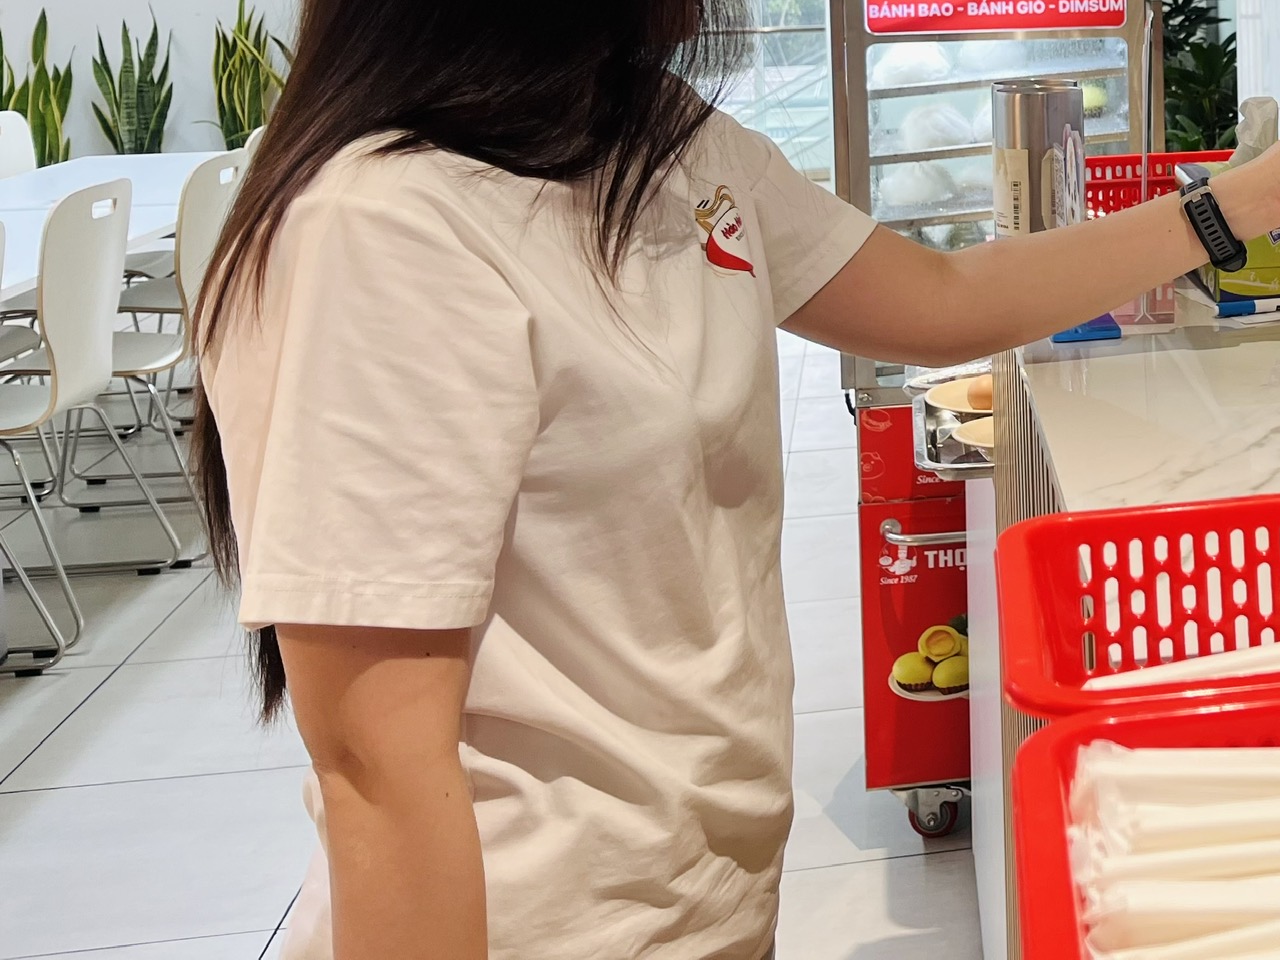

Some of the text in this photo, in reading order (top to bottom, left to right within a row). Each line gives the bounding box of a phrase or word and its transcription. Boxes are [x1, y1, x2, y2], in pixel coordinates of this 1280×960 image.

[868, 1, 915, 19] BÁNH
[918, 2, 954, 18] BAO
[880, 574, 918, 585] Since 1987
